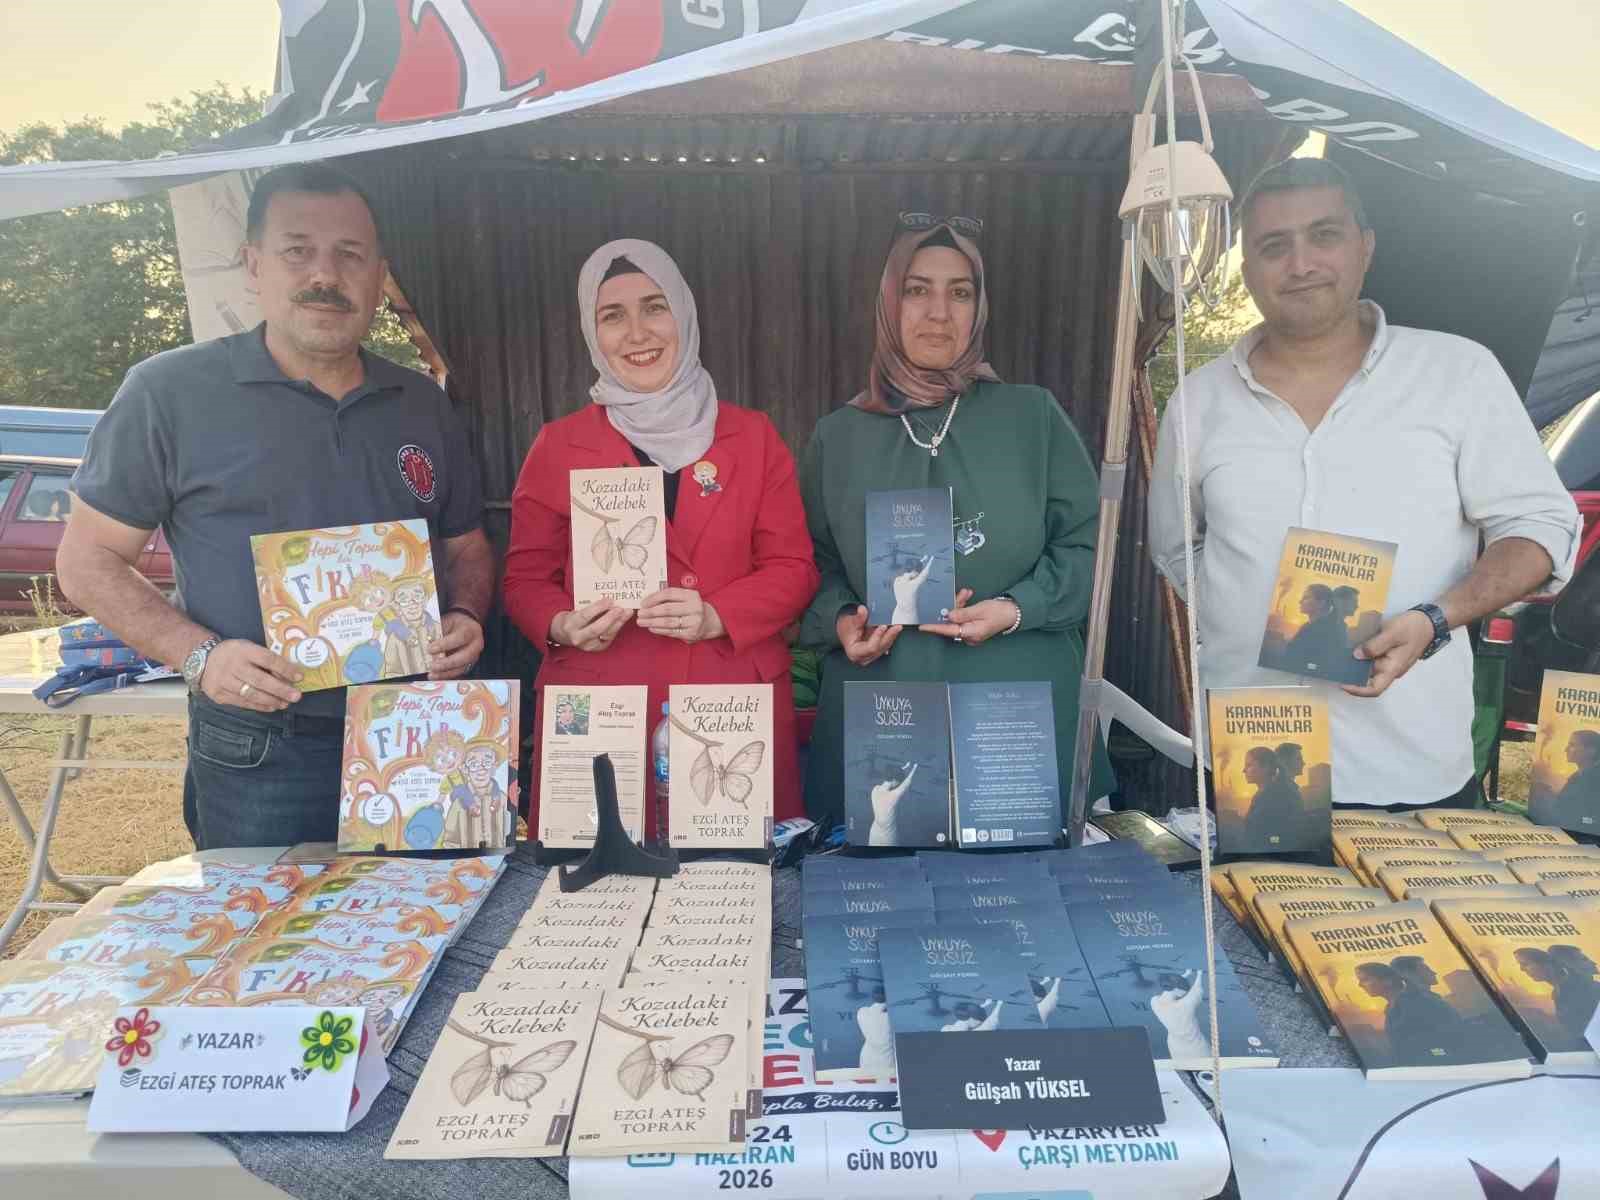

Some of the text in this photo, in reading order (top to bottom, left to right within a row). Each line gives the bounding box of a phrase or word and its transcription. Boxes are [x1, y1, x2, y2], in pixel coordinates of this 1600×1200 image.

[582, 477, 650, 494] Kozadaki
[592, 495, 647, 511] Kelebek
[1297, 543, 1378, 568] KARANLIKTA
[1295, 556, 1376, 582] UYANANLAR
[594, 580, 617, 590] EZGİ
[682, 696, 760, 714] Kozadaki
[873, 693, 913, 711] UYKUYA
[875, 711, 916, 726] SUSUZ
[1225, 705, 1312, 719] KARANLIKTA
[692, 716, 756, 733] Kelebek
[1226, 719, 1313, 734] UYANANLAR
[692, 813, 750, 827] EZGİ ATEŞ
[698, 827, 745, 837] TOPRAK
[1470, 831, 1557, 842] KARANLIKTA
[1351, 836, 1438, 848] KARANLIKTA
[1250, 875, 1344, 886] KARANLIKTA
[1403, 873, 1499, 888] KARANLIKTA
[546, 898, 635, 911] Kozadaki
[670, 897, 755, 908] Kozadaki
[1280, 900, 1375, 912] KARANLIKTA
[534, 915, 627, 928] Kozadaki
[664, 914, 755, 926] Kozadaki
[1109, 910, 1160, 925] UYKUYA
[1462, 911, 1570, 924] KARANLIKTA
[1118, 924, 1168, 937] SUSUZ
[1311, 918, 1419, 942] KARANLIKTA
[1471, 924, 1582, 937] UYANANLAR
[523, 935, 622, 949] Kozadaki
[656, 934, 753, 947] Kozadaki
[921, 936, 972, 952] UYKUYA
[1318, 932, 1428, 954] UYANANLAR
[507, 956, 609, 971] Kozadaki
[649, 954, 750, 968] Kozadaki
[927, 951, 978, 966] SUSUZ
[467, 1000, 581, 1017] Kozadaki
[618, 994, 729, 1012] Kozadaki
[475, 1017, 567, 1034] Kelebek
[629, 1011, 720, 1028] Kelebek
[197, 1033, 254, 1049] YAZAR
[1004, 1057, 1041, 1072] Yazar
[139, 1072, 286, 1093] EZGİ ATEŞ TOPRAK
[965, 1077, 1090, 1104] Gülşah YÜKSEL
[814, 1094, 884, 1111] Buluş,
[435, 1113, 530, 1127] EZGİ ATEŞ
[613, 1107, 708, 1121] EZGİ ATEŞ
[440, 1127, 518, 1141] TOPRAK
[620, 1121, 698, 1134] TOPRAK
[847, 1149, 938, 1170] GÜN BOYU
[1018, 1141, 1179, 1170] ÇARŞI MEYDANI
[719, 1169, 773, 1188] 2026
